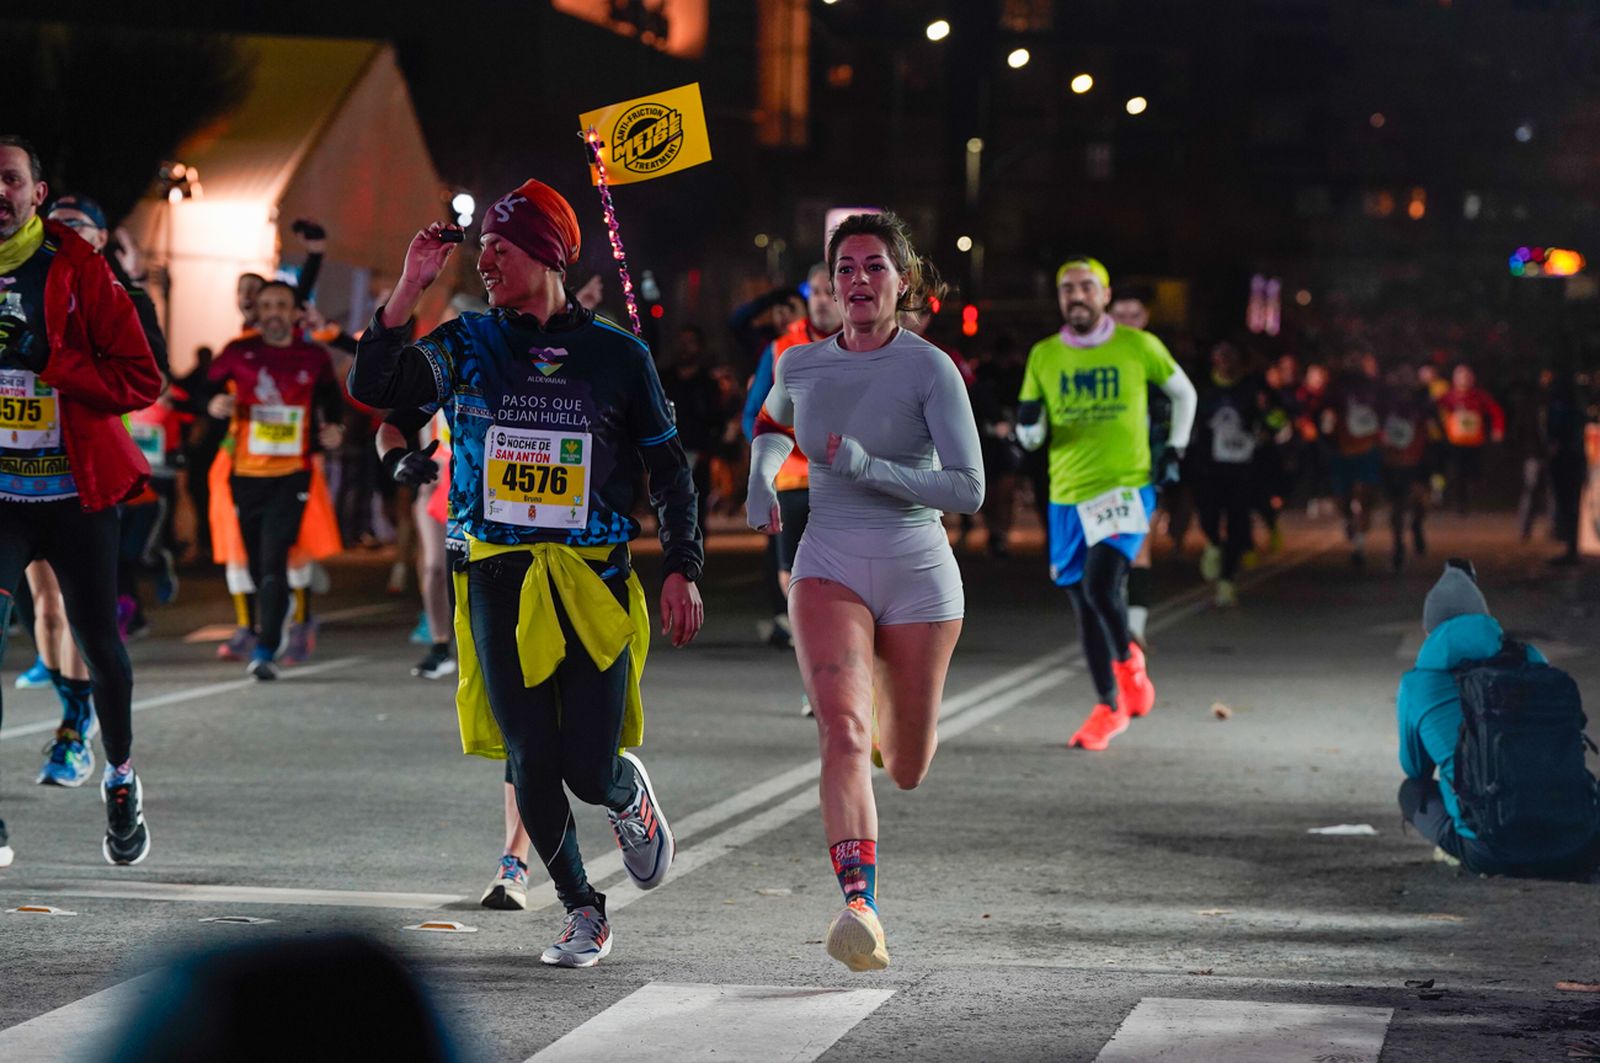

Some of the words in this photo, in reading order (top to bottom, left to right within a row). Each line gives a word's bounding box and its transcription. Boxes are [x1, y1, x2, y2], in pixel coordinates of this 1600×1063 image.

[617, 107, 664, 140] ANTI-FRICTION
[635, 143, 677, 169] TREATMENT
[0, 397, 42, 422] 575
[502, 394, 547, 409] PASOS
[552, 398, 583, 411] QUE
[497, 409, 538, 422] DEJAN
[507, 438, 537, 451] NOCHE
[538, 440, 552, 451] DE
[495, 449, 515, 461] SAN
[515, 450, 551, 464] ANTÓN
[502, 463, 568, 495] 4576
